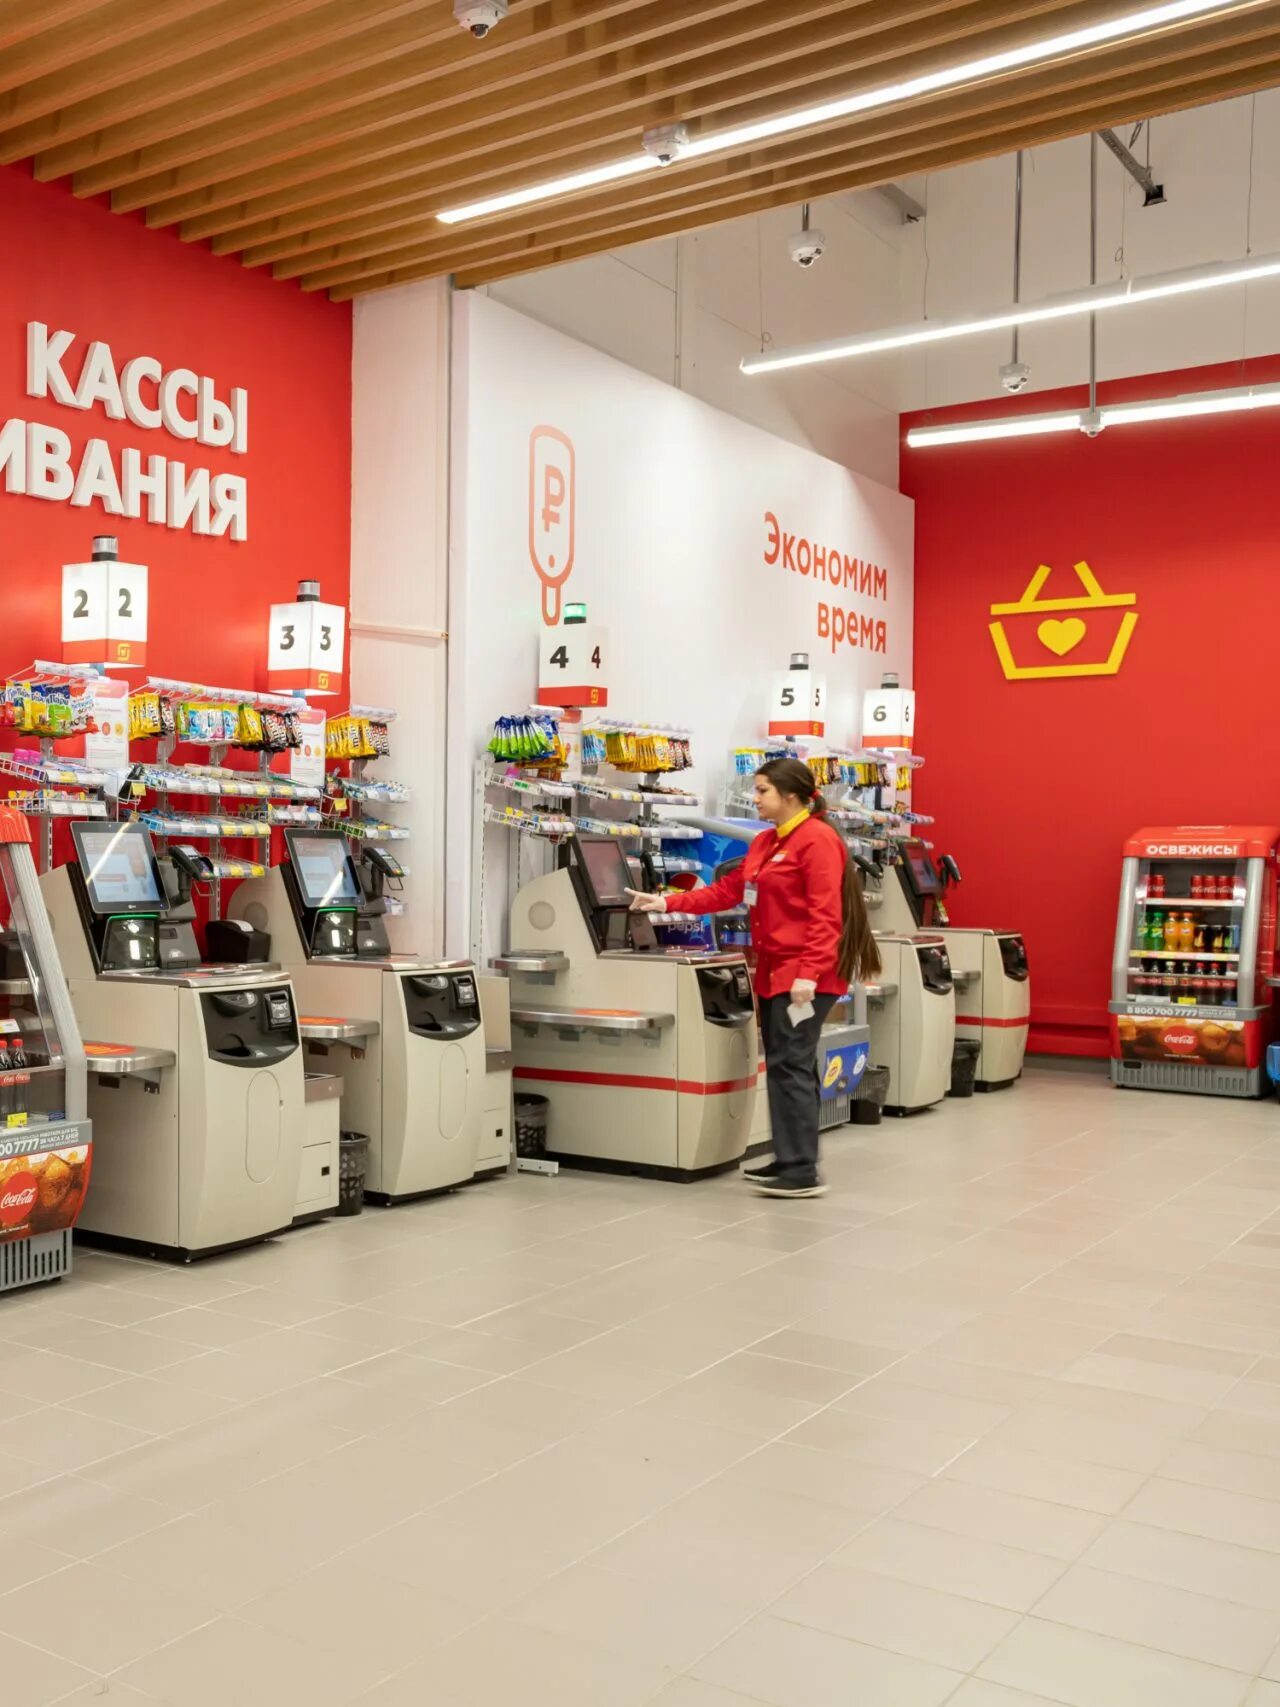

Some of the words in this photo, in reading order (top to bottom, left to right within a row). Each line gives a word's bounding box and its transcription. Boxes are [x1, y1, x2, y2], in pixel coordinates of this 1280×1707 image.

[26, 321, 248, 454] КАССЫ
[764, 512, 888, 601] Экономим
[73, 589, 89, 618] 2
[118, 588, 132, 618] 2
[279, 625, 295, 650] 3
[319, 625, 332, 651] 3
[817, 602, 888, 653] время
[549, 645, 569, 669] 4
[591, 645, 601, 669] 4
[780, 687, 795, 707] 5
[814, 688, 820, 707] 5
[872, 705, 887, 722] 6
[904, 705, 910, 723] 6
[1146, 844, 1238, 856] ОСВЕЖИСЬ!
[1134, 1007, 1154, 1015] 800
[1154, 1007, 1173, 1015] 700
[1174, 1008, 1198, 1017] 7777
[14, 1138, 40, 1154] 7777
